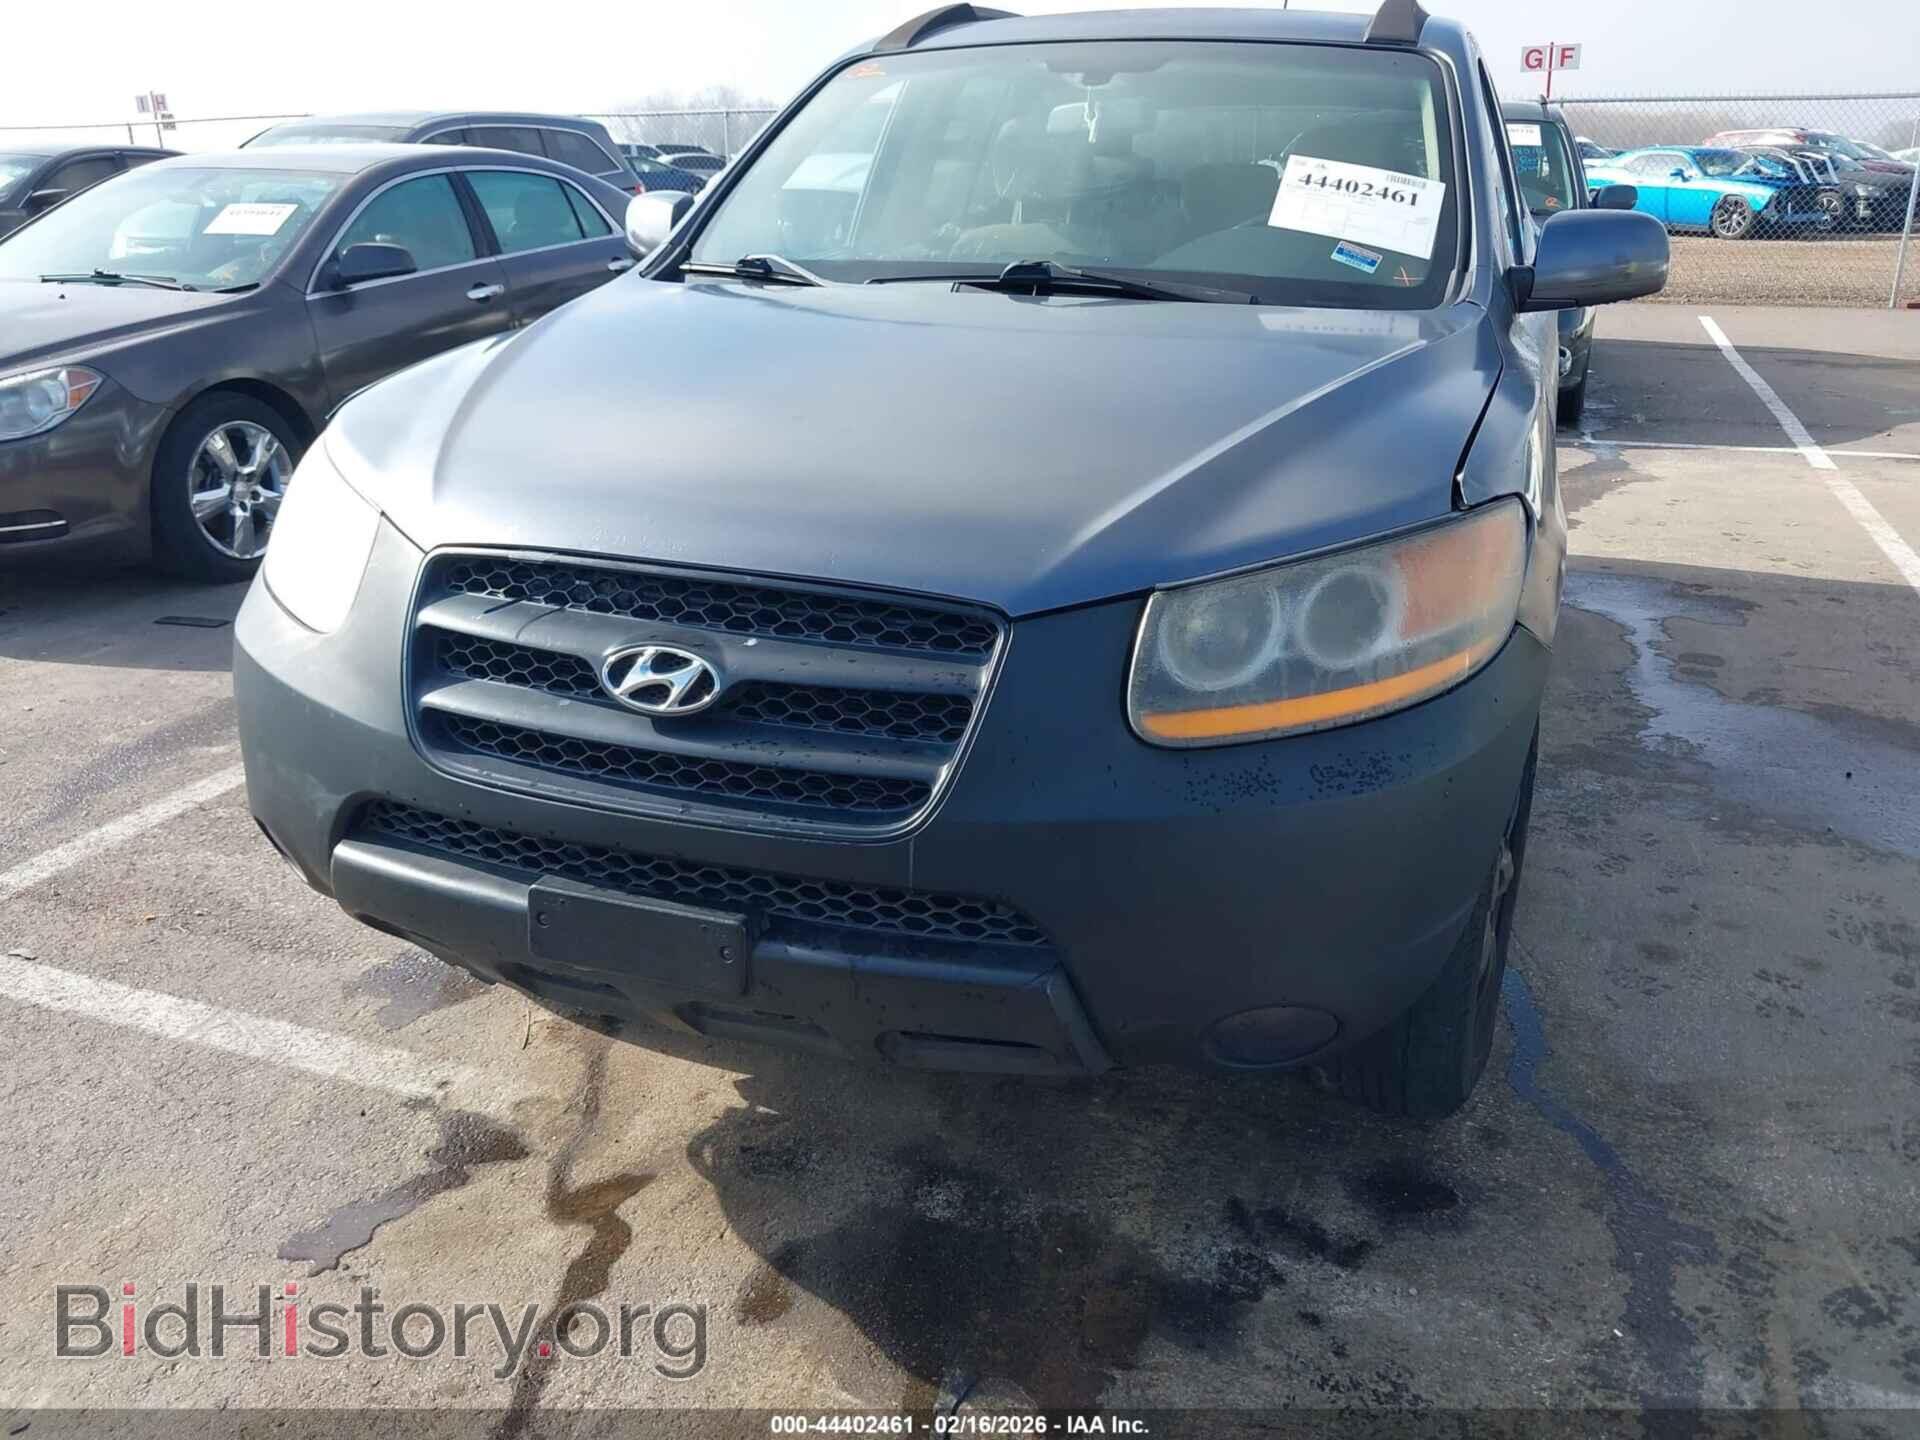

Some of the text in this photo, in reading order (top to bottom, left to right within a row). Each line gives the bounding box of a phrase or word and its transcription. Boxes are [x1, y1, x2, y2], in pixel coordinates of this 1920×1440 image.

[1524, 47, 1576, 69] G F
[154, 95, 166, 111] H
[1298, 172, 1419, 206] 44402461
